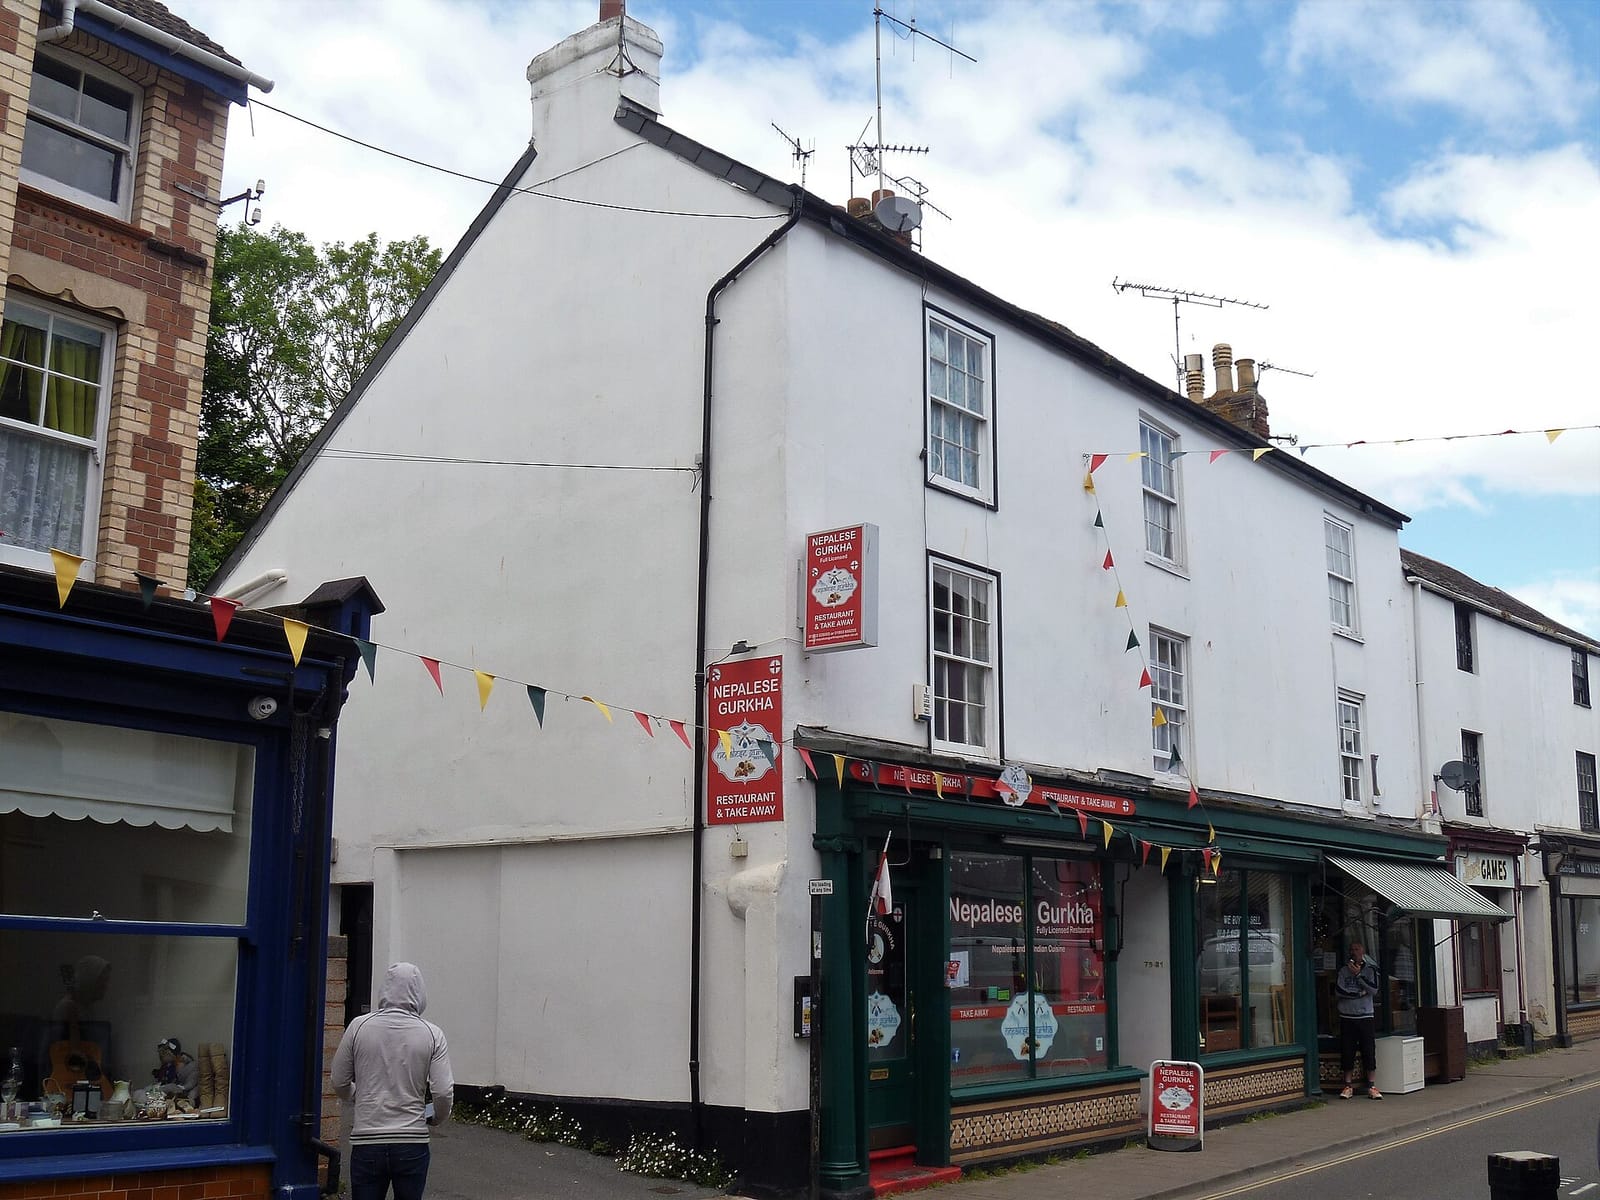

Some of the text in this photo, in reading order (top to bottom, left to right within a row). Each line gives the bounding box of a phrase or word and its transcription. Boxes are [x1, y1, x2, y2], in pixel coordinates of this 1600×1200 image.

[812, 531, 856, 546] NEPALESE
[815, 542, 852, 556] GURKHA
[815, 610, 854, 622] RESTAURANT
[820, 621, 836, 629] TAKE
[837, 618, 854, 627] AWAY
[713, 678, 779, 699] NEPALESE
[718, 696, 774, 715] GURKHA
[932, 775, 962, 789] GRKHA
[716, 791, 776, 806] RESTAURANT
[1042, 791, 1117, 809] RESTAURANT & TAKE AWAY
[716, 805, 776, 818] & TAKE AWAY
[1481, 859, 1507, 880] GAMES
[949, 896, 1094, 929] Nepalese Gurkha
[1036, 926, 1094, 936] Fully Licensed Restaurant
[991, 945, 1066, 954] Nepalese and ndian Cuisine
[960, 1009, 989, 1018] TAKE AWAY
[1067, 1005, 1096, 1013] RESTAURANT
[1160, 1069, 1194, 1077] NEPALESE
[1162, 1075, 1191, 1084] GURKHA
